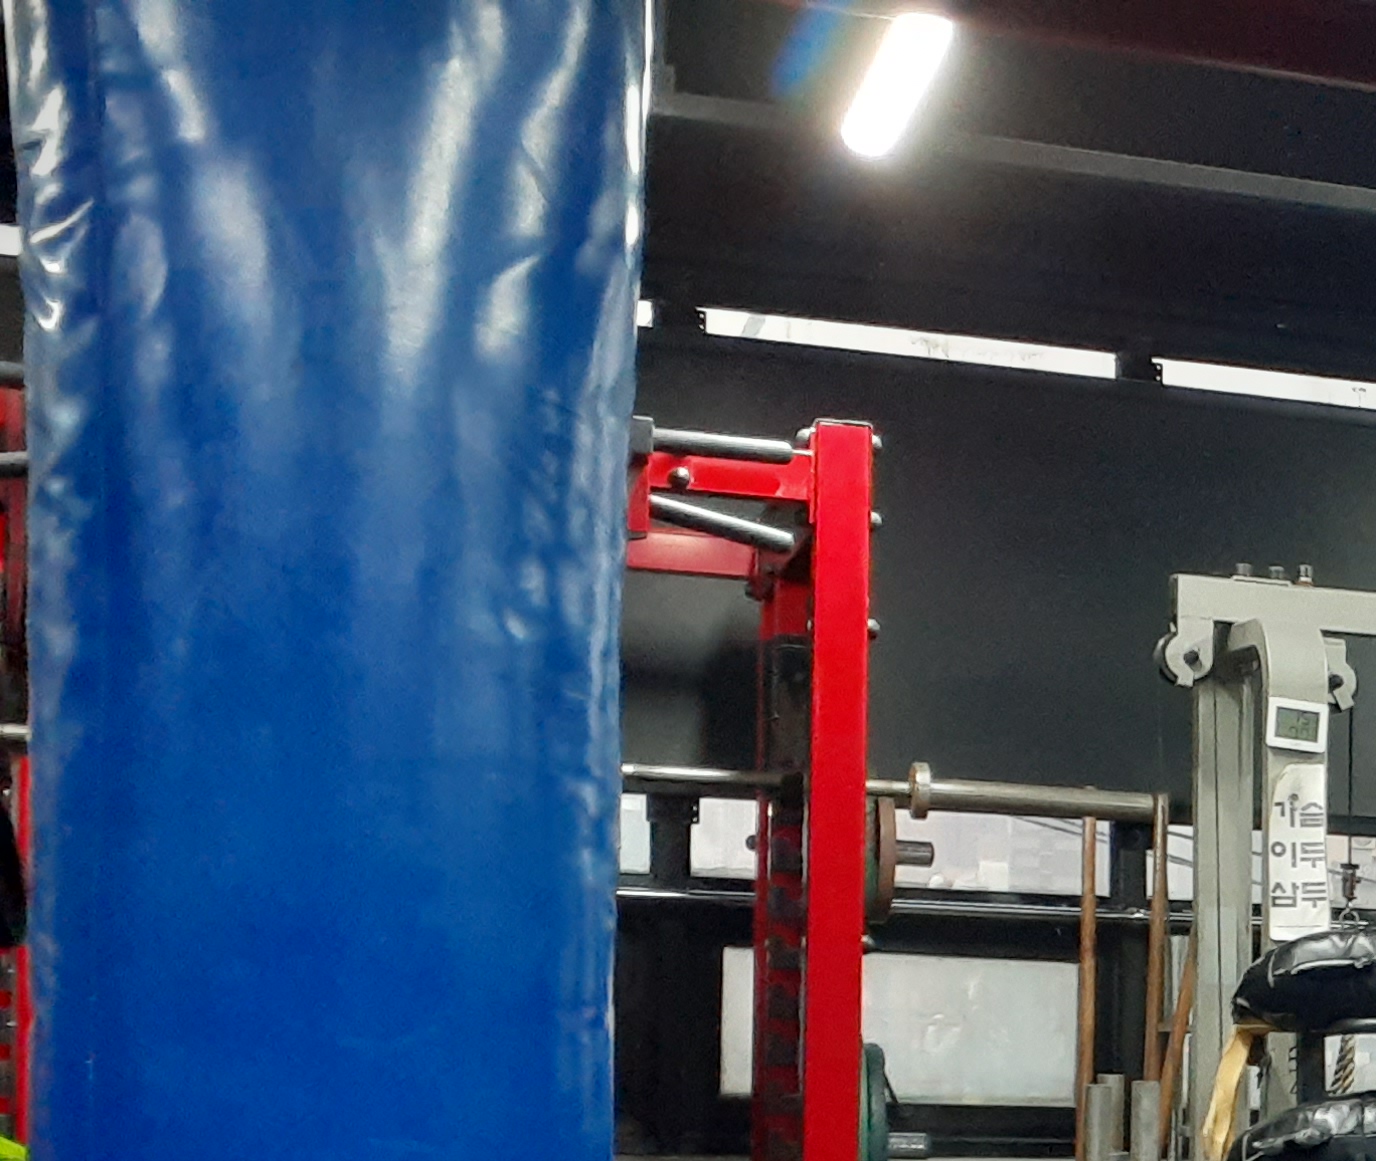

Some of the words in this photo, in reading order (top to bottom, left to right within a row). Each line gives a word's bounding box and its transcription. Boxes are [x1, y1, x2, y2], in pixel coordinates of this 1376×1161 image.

[1274, 801, 1325, 829] 가슴
[1271, 841, 1325, 869] 이두
[1271, 881, 1328, 909] 삼두
